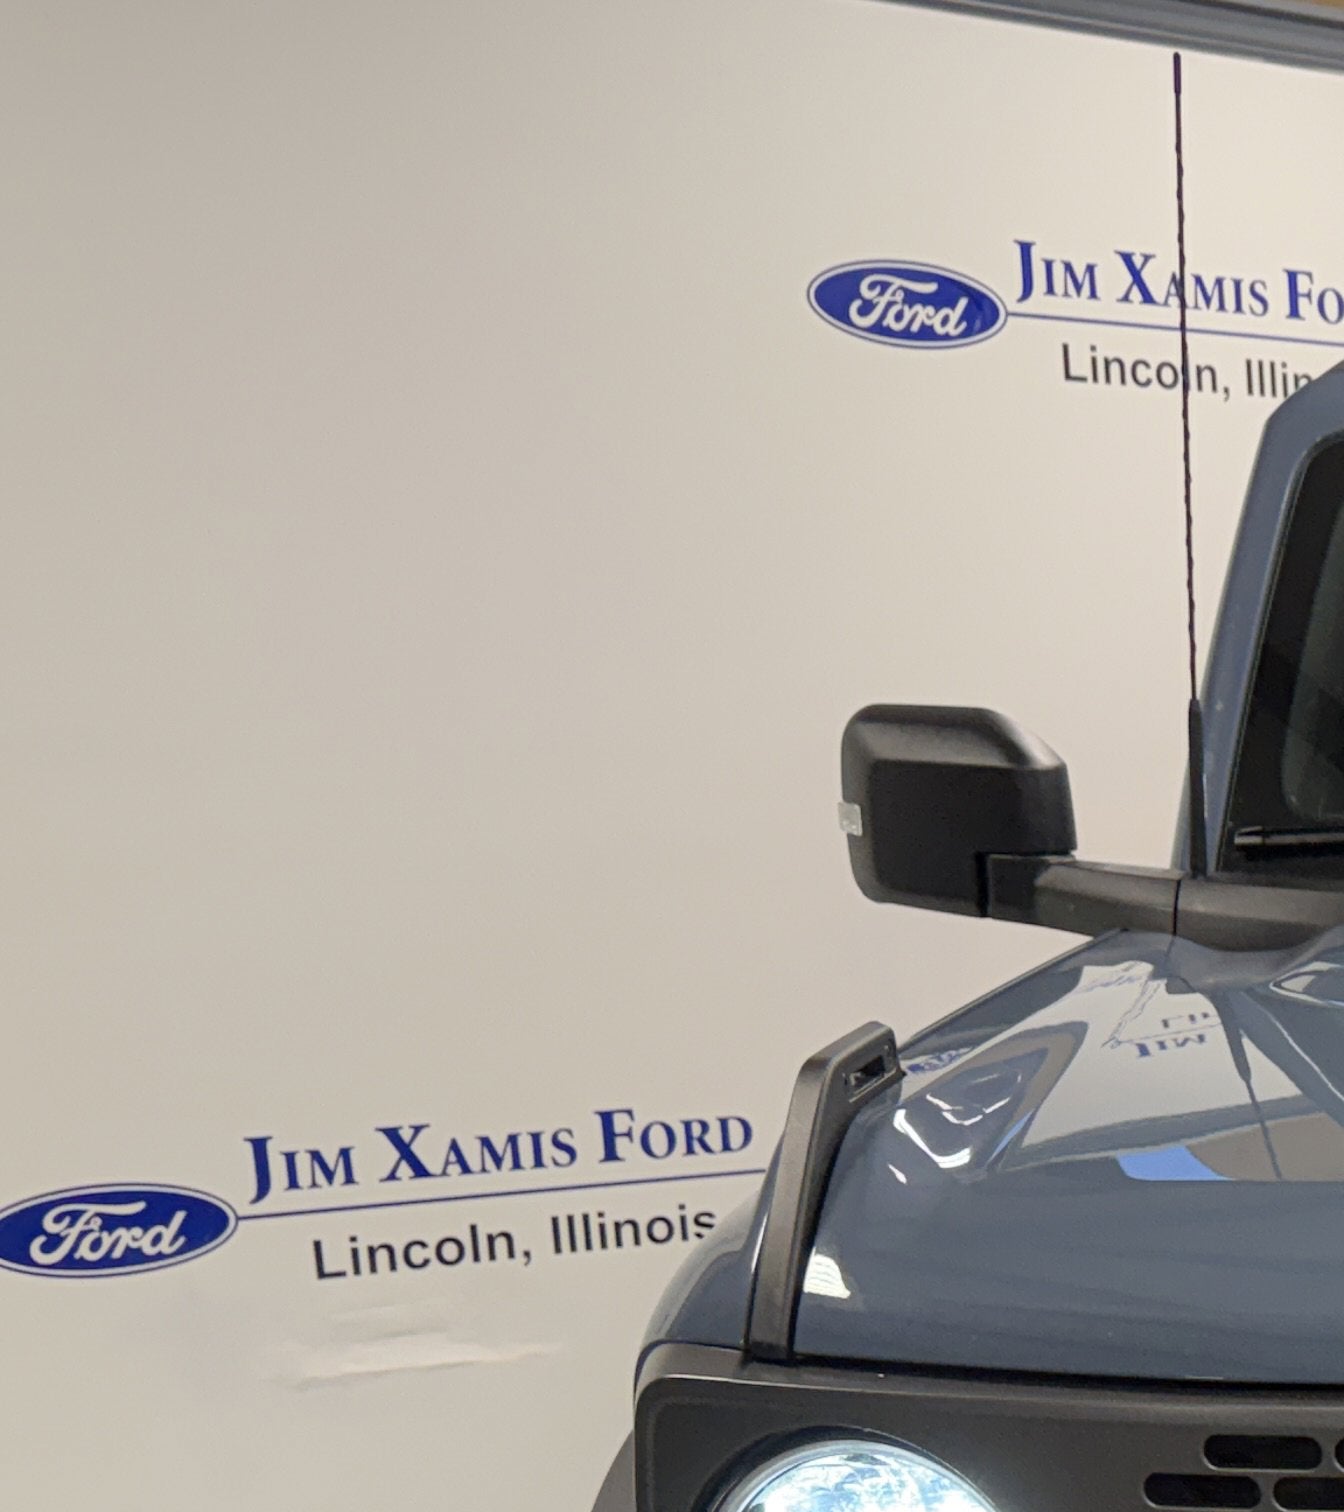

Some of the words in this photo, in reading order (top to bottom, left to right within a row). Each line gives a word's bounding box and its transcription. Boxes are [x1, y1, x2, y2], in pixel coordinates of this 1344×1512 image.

[848, 272, 968, 338] Ford
[1014, 239, 1101, 303] JIM
[1115, 250, 1270, 318] XAMIS
[243, 1135, 358, 1204] JIM
[373, 1123, 577, 1182] XAMIS
[594, 1108, 753, 1164] FORD
[28, 1201, 186, 1266] Ford
[312, 1224, 533, 1280] Lincoln,
[551, 1204, 717, 1258] Illinois
